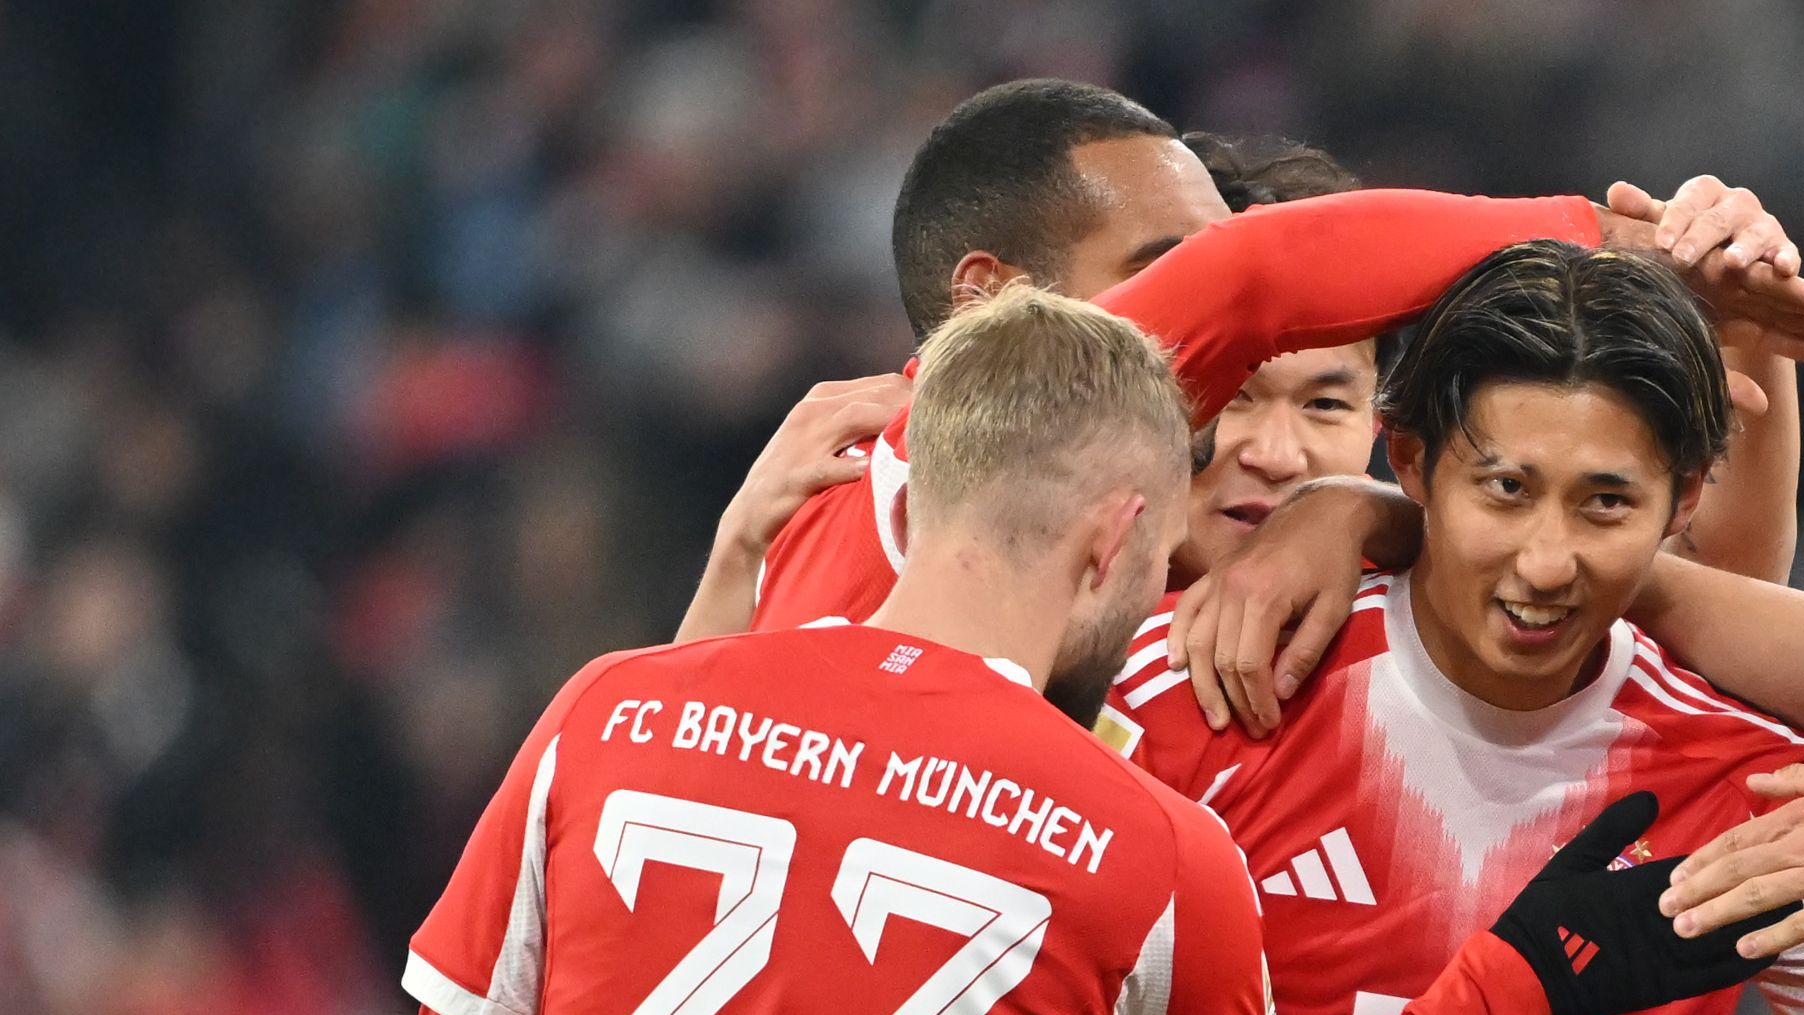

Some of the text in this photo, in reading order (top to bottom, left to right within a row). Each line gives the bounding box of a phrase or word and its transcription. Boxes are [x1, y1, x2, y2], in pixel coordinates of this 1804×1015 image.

[601, 699, 1114, 874] FC BAYERN MÜNCHEN
